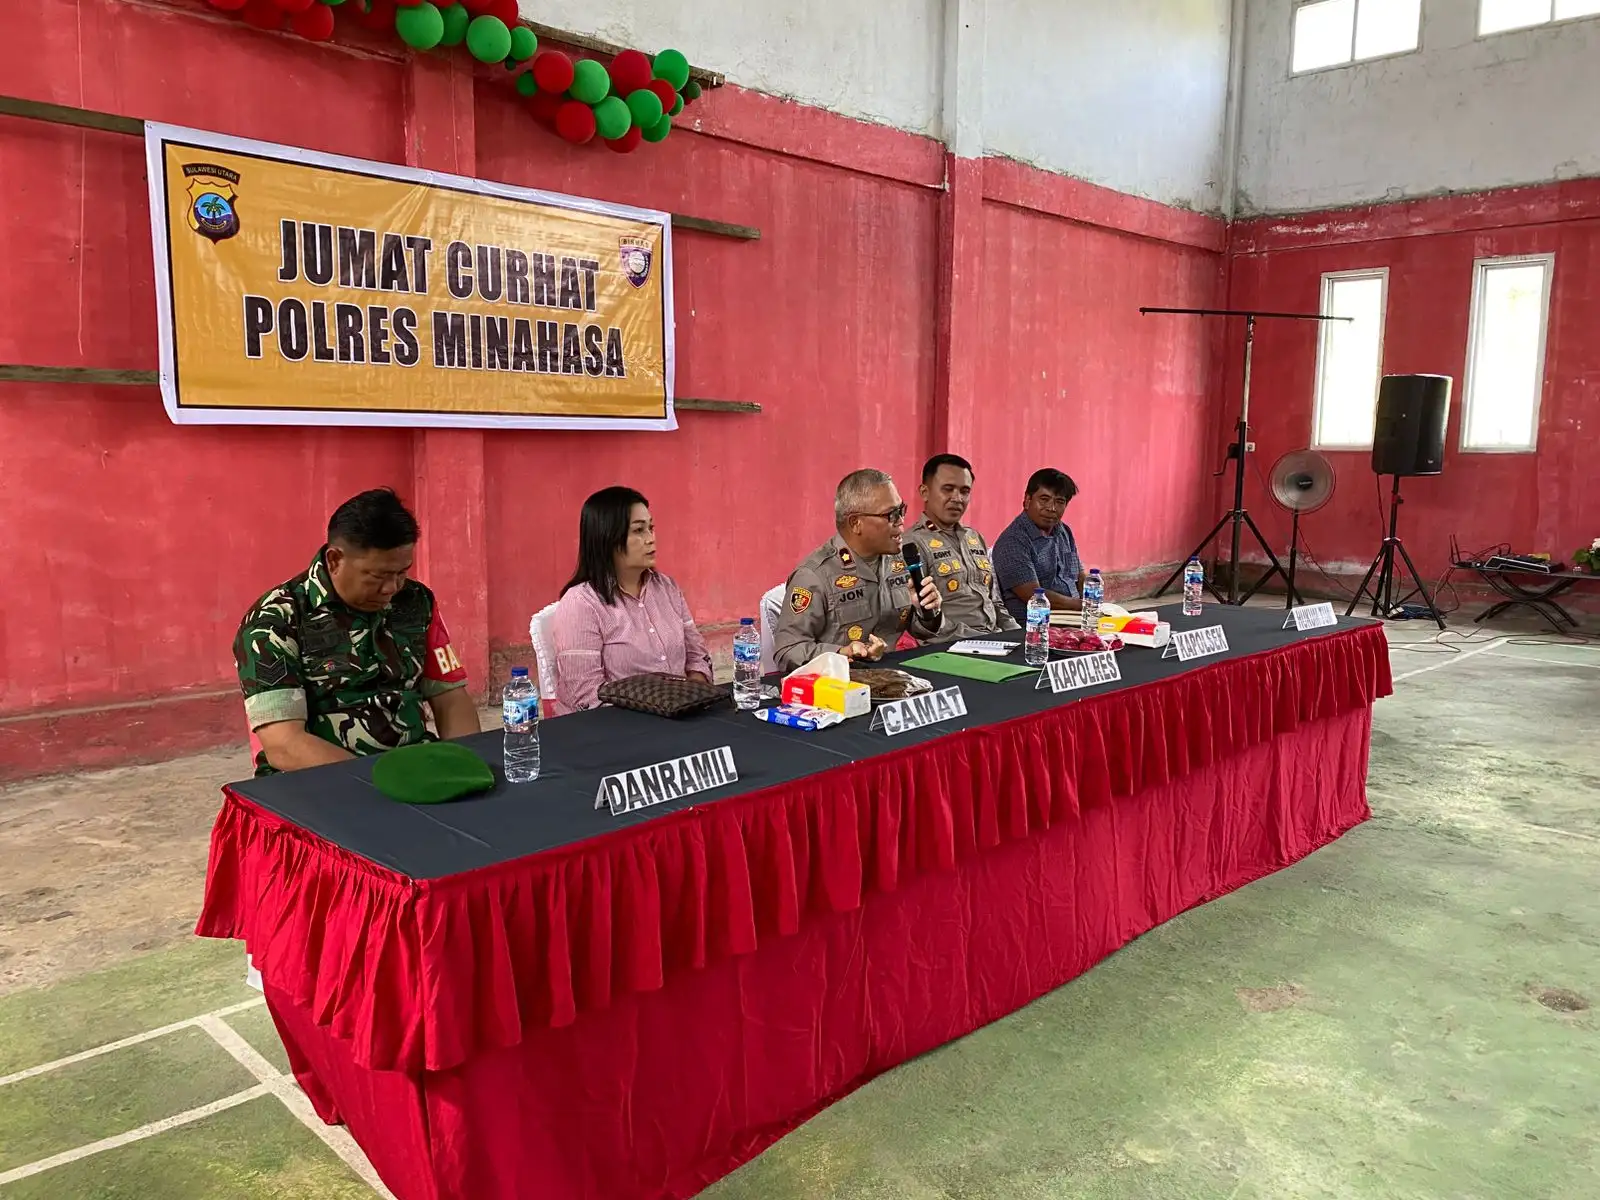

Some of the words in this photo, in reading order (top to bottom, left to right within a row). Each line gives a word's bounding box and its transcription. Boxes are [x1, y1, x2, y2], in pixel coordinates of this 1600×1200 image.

[185, 166, 217, 175] SULAWESI
[217, 168, 238, 181] UTARA
[277, 218, 432, 295] JUMAT
[446, 239, 600, 312] CURHAT
[243, 294, 420, 368] POLRES
[432, 311, 627, 379] MINAHASA
[839, 589, 864, 603] JON
[1177, 628, 1229, 660] KAPOLSEK
[1052, 653, 1122, 692] KAPOLRES
[881, 686, 967, 734] CAMAT
[604, 747, 738, 814] DANRAMIL
